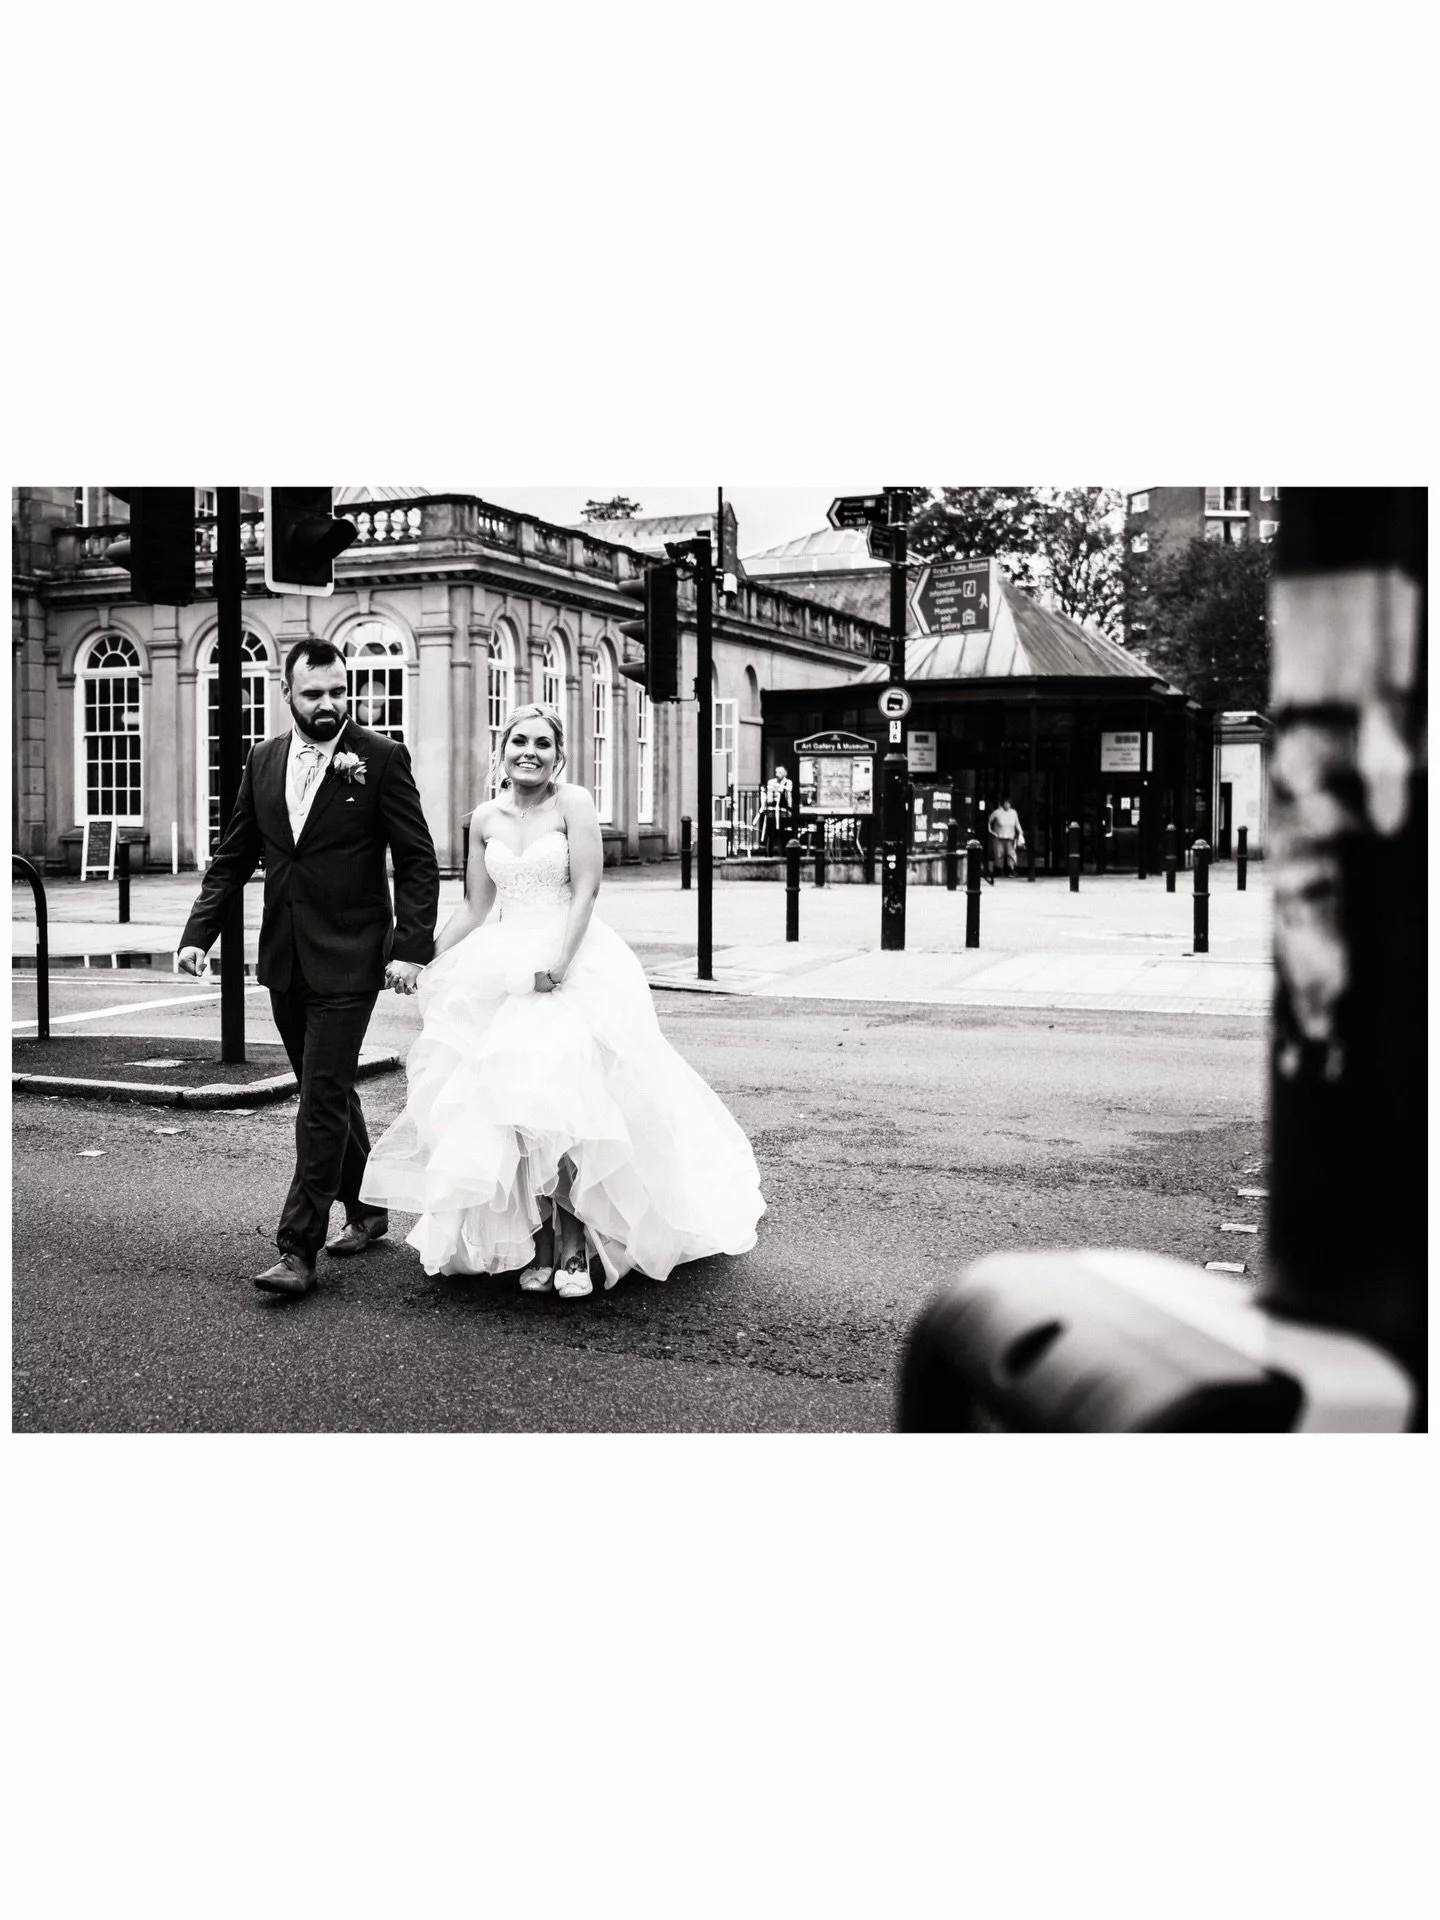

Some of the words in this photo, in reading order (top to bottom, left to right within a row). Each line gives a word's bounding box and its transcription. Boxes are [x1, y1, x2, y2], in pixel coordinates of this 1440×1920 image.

[932, 567, 948, 575] Royal
[951, 565, 967, 573] Pump
[935, 580, 955, 588] Tourist
[936, 597, 954, 605] centre
[934, 607, 958, 615] Museum
[941, 622, 960, 631] gallery
[812, 743, 836, 752] Gallery
